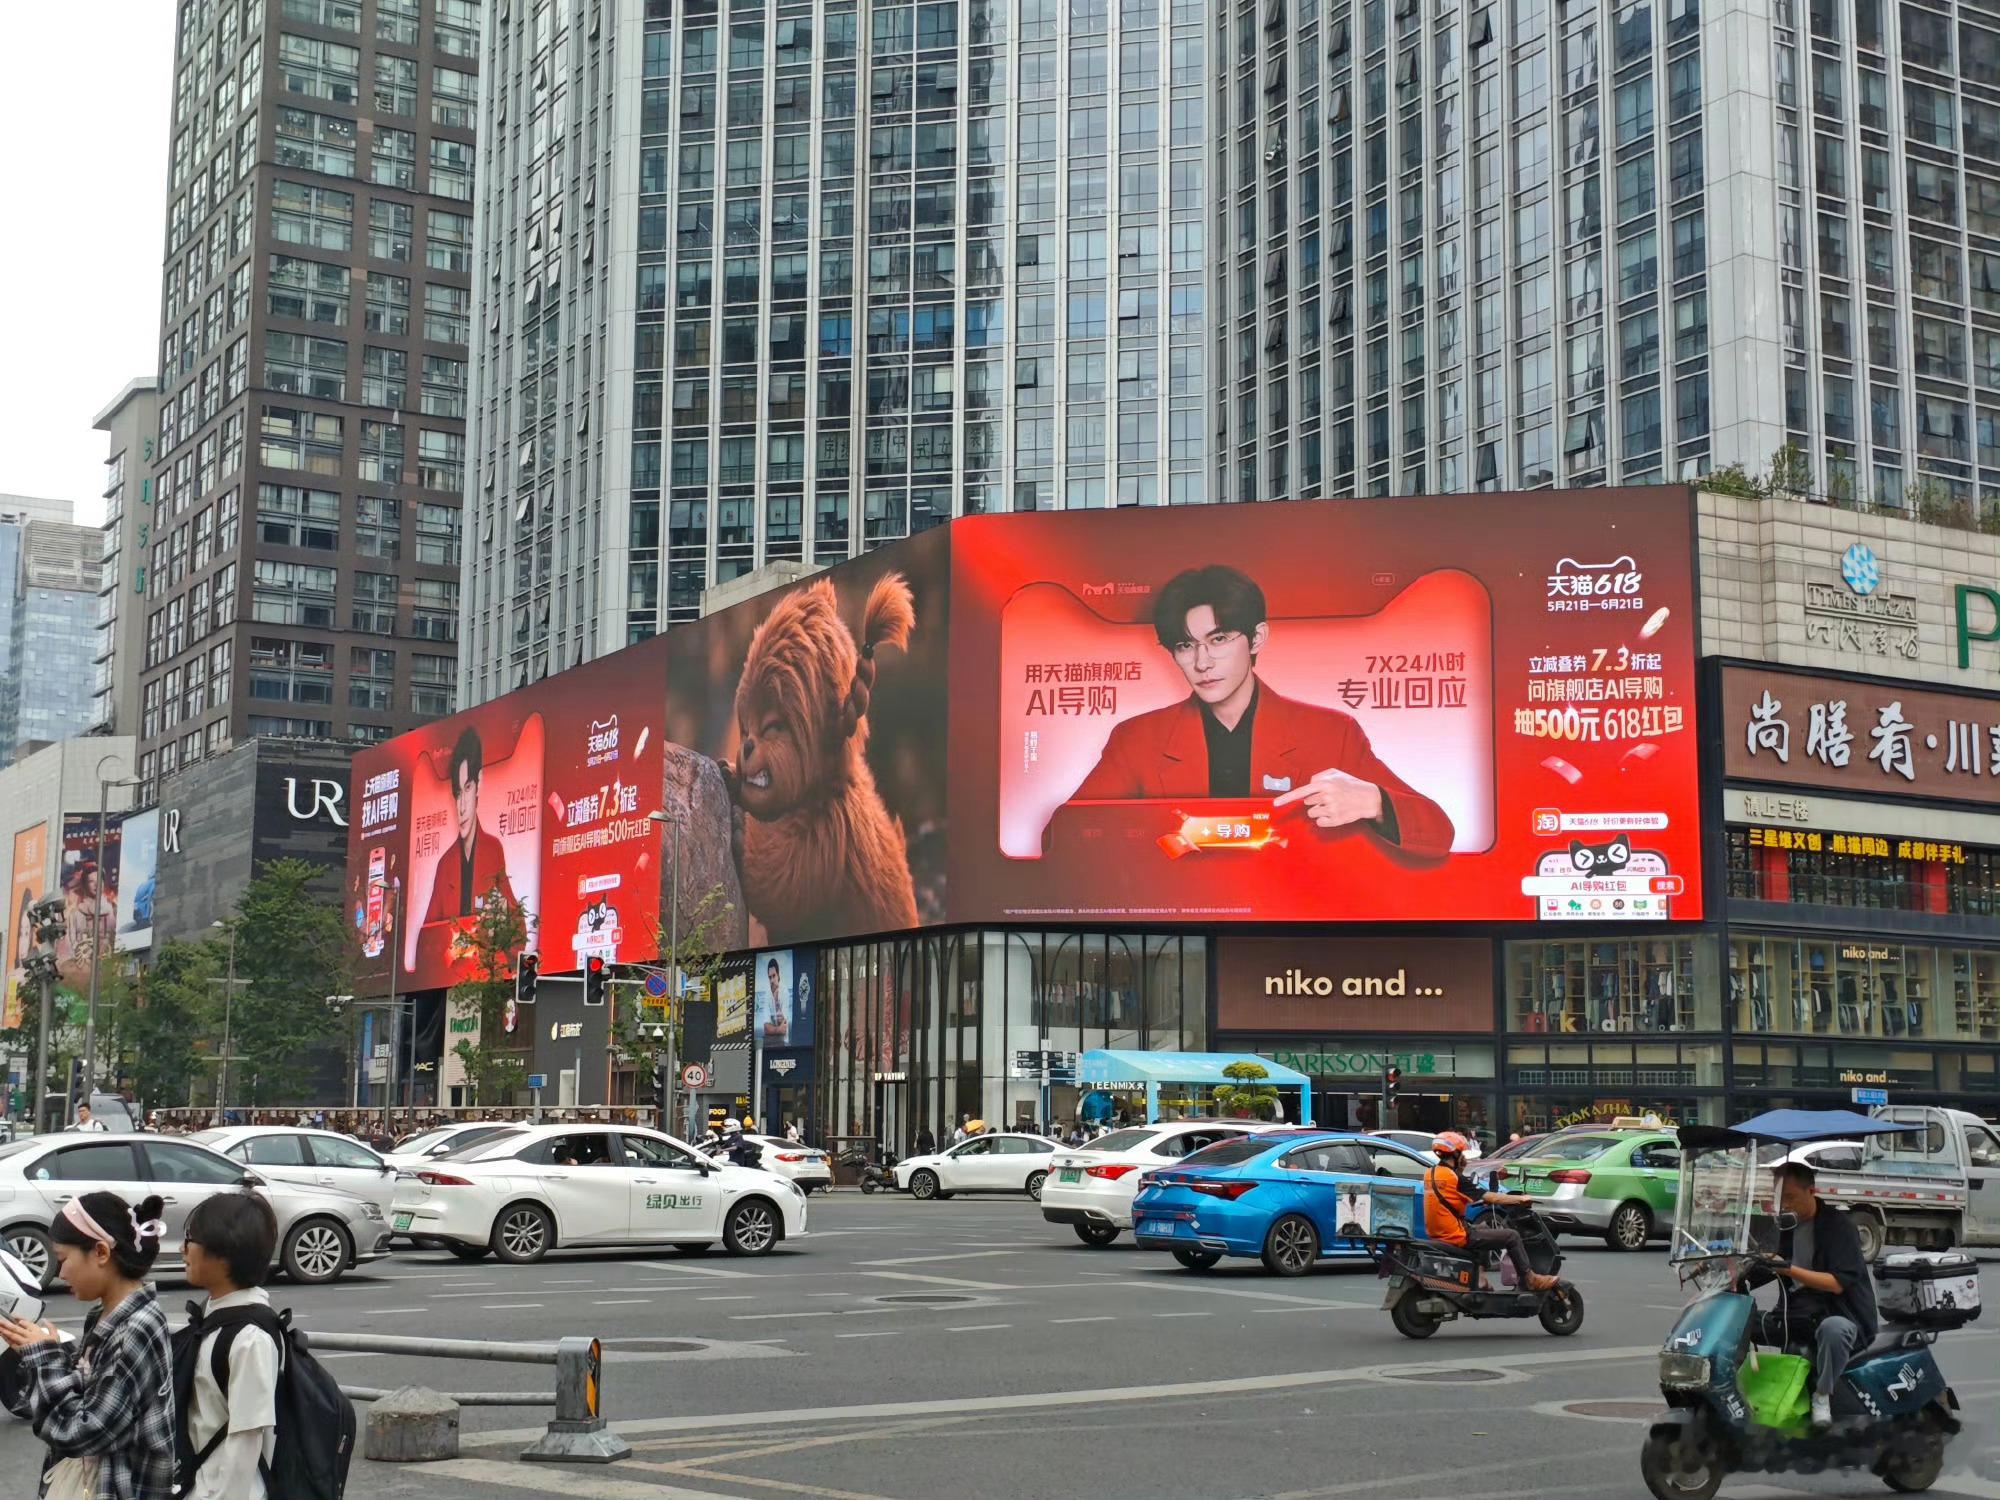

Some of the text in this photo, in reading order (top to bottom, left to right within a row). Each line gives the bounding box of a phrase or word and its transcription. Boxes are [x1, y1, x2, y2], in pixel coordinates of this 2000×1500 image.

[1547, 572, 1642, 597] 天猫618
[1808, 586, 1915, 619] TIMES PLAZA
[1025, 661, 1142, 683] 用天猫旗舰店
[1365, 652, 1466, 673] 7X24小时
[1026, 685, 1117, 715] AI导购
[1337, 676, 1467, 709] 专业回应
[1528, 676, 1663, 702] 问旗舰店AI导购
[284, 778, 349, 826] UR
[362, 792, 399, 828] 找AI导购
[1745, 795, 1809, 821] 请上三楼
[164, 809, 181, 853] UR
[499, 804, 537, 837] 专业回应
[1217, 824, 1250, 838] 导购
[1833, 834, 1889, 858] 熊猫周边
[1898, 841, 1966, 865] 成都伴手礼
[1571, 880, 1627, 892] AI导购红包
[1842, 946, 1866, 959] niko
[1867, 947, 1889, 960] and
[1265, 969, 1333, 996] niko
[1342, 969, 1406, 996] and
[1273, 1050, 1386, 1073] PARKSON
[686, 1071, 702, 1081] 40
[1090, 1081, 1135, 1090] TEENMIX
[1840, 1070, 1863, 1083] niko
[1866, 1071, 1887, 1083] and
[646, 1194, 703, 1209] 绿贝出行
